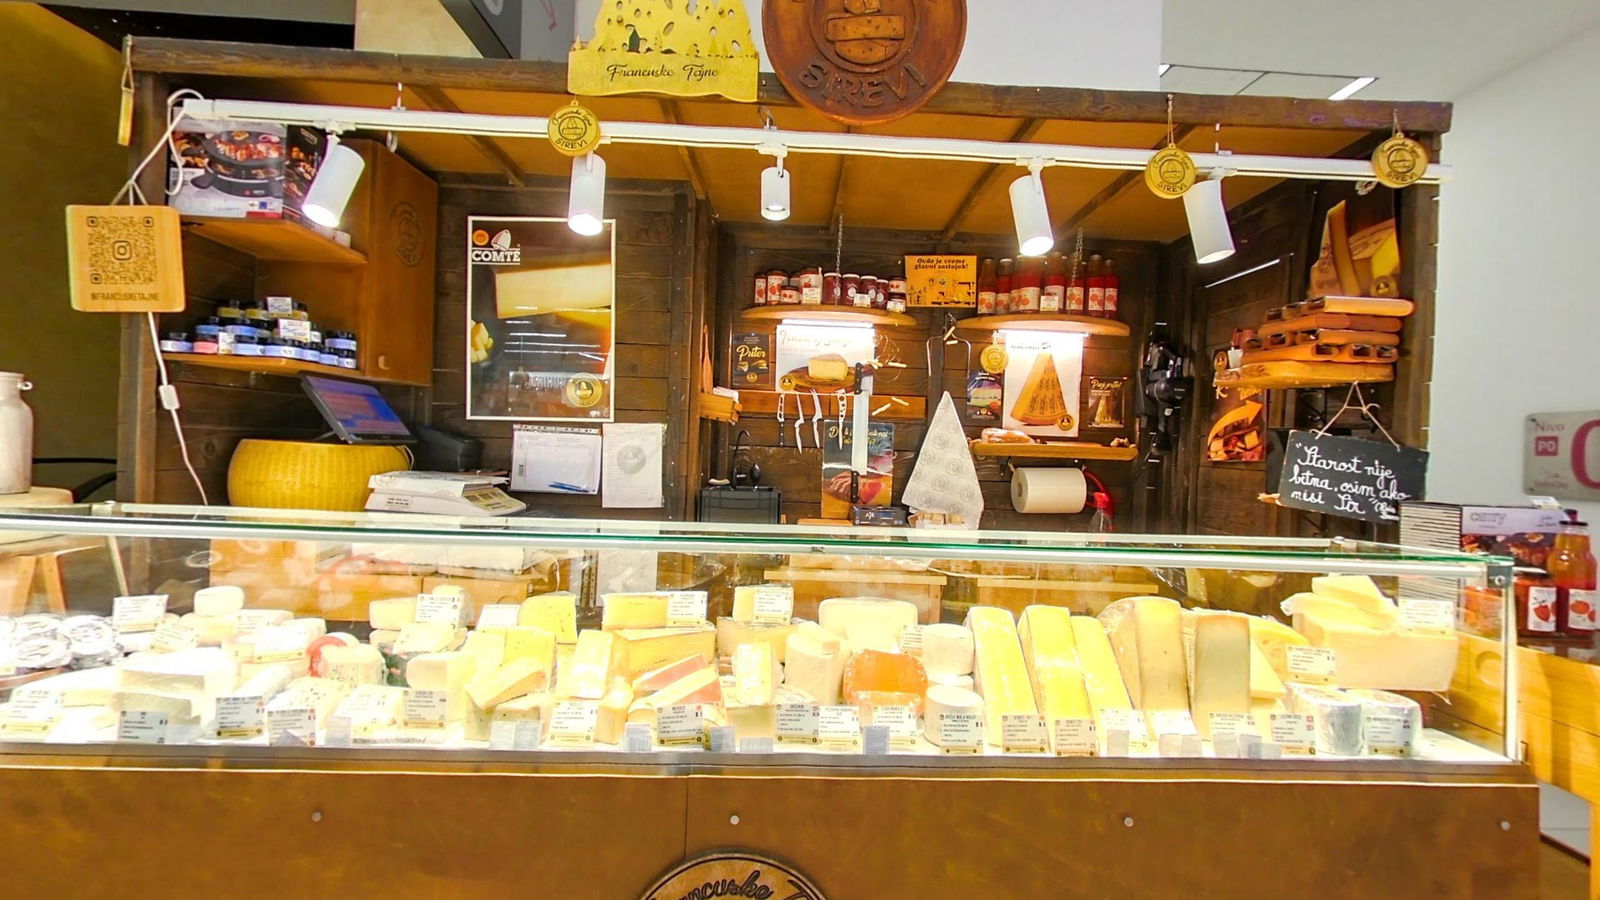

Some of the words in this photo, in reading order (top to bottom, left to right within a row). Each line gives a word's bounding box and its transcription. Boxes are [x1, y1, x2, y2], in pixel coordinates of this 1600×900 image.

[607, 64, 673, 81] Francuske
[683, 64, 718, 81] Tajne
[800, 63, 926, 108] SIREVI
[555, 139, 587, 149] SIREVI
[1364, 460, 1395, 489] nije
[1291, 490, 1325, 504] nisi
[1340, 481, 1376, 497] osim
[1379, 479, 1411, 500] ako
